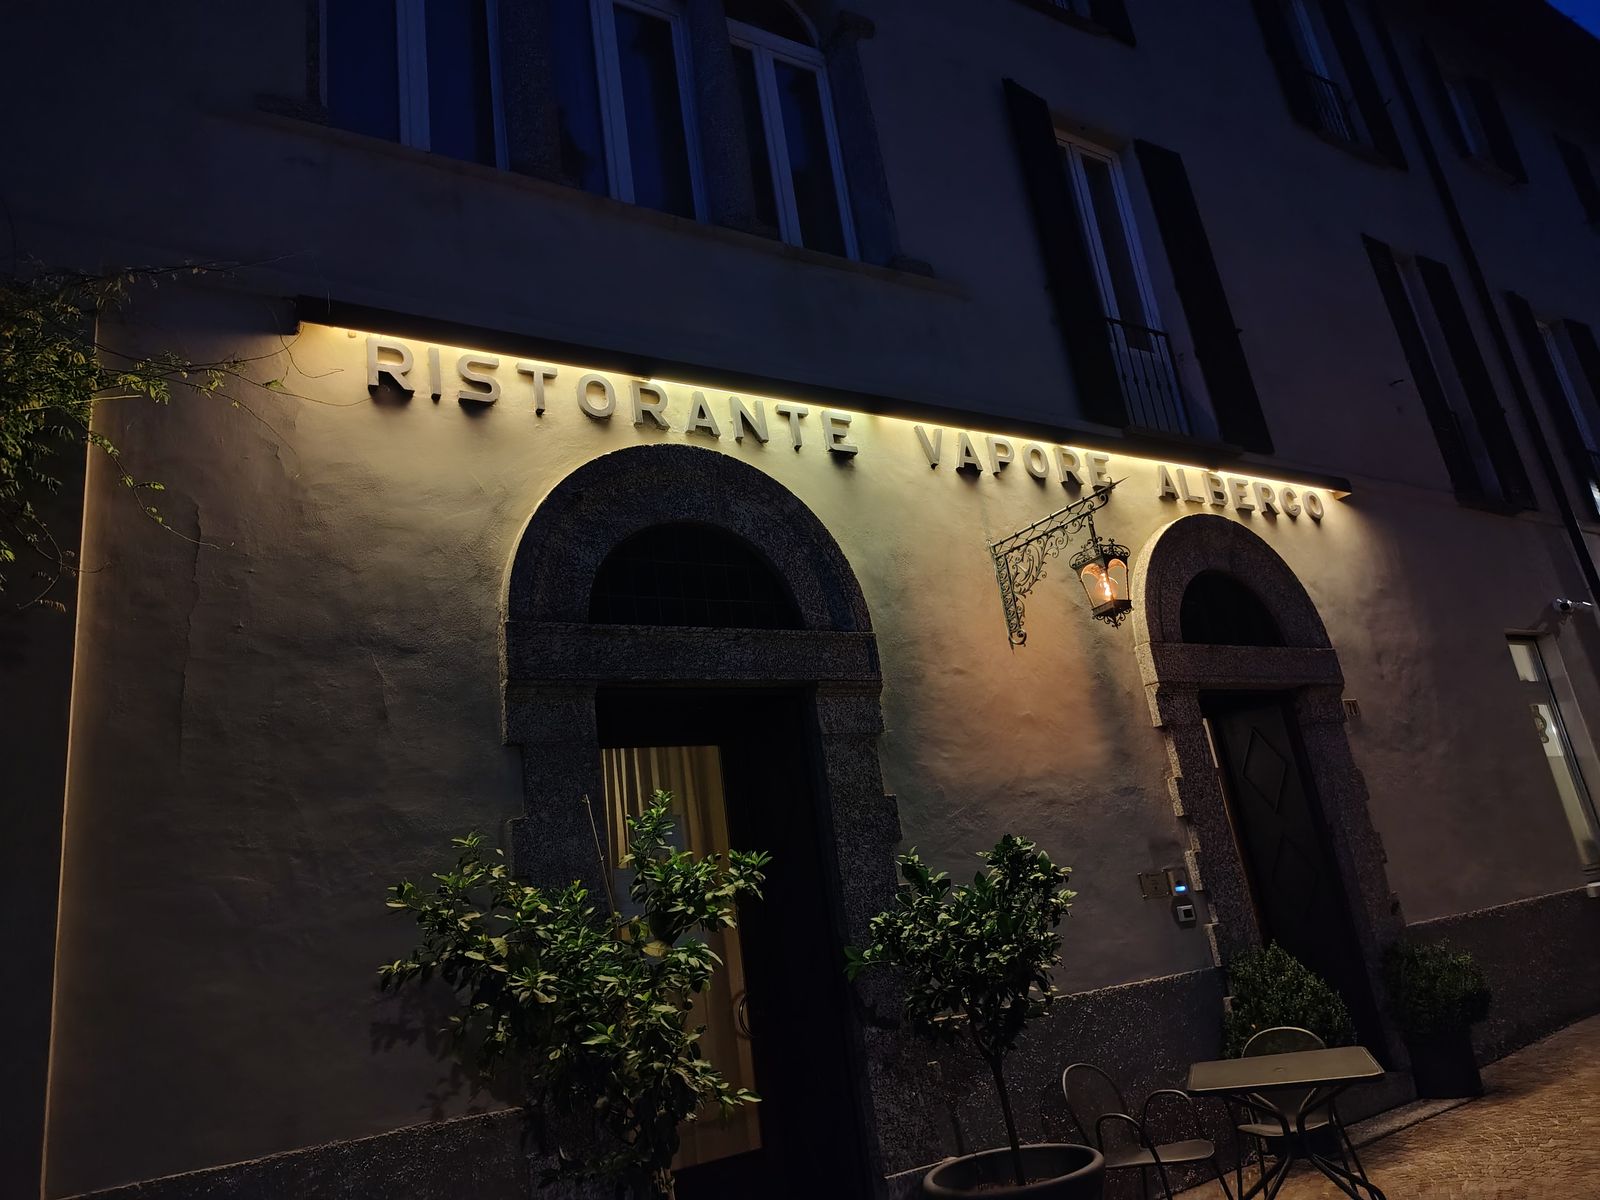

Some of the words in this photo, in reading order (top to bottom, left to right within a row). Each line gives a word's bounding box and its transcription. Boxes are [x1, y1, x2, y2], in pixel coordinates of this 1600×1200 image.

[367, 336, 858, 455] RISTORANTE
[914, 425, 1110, 488] VAPORE
[1159, 464, 1325, 520] ALBERGO
